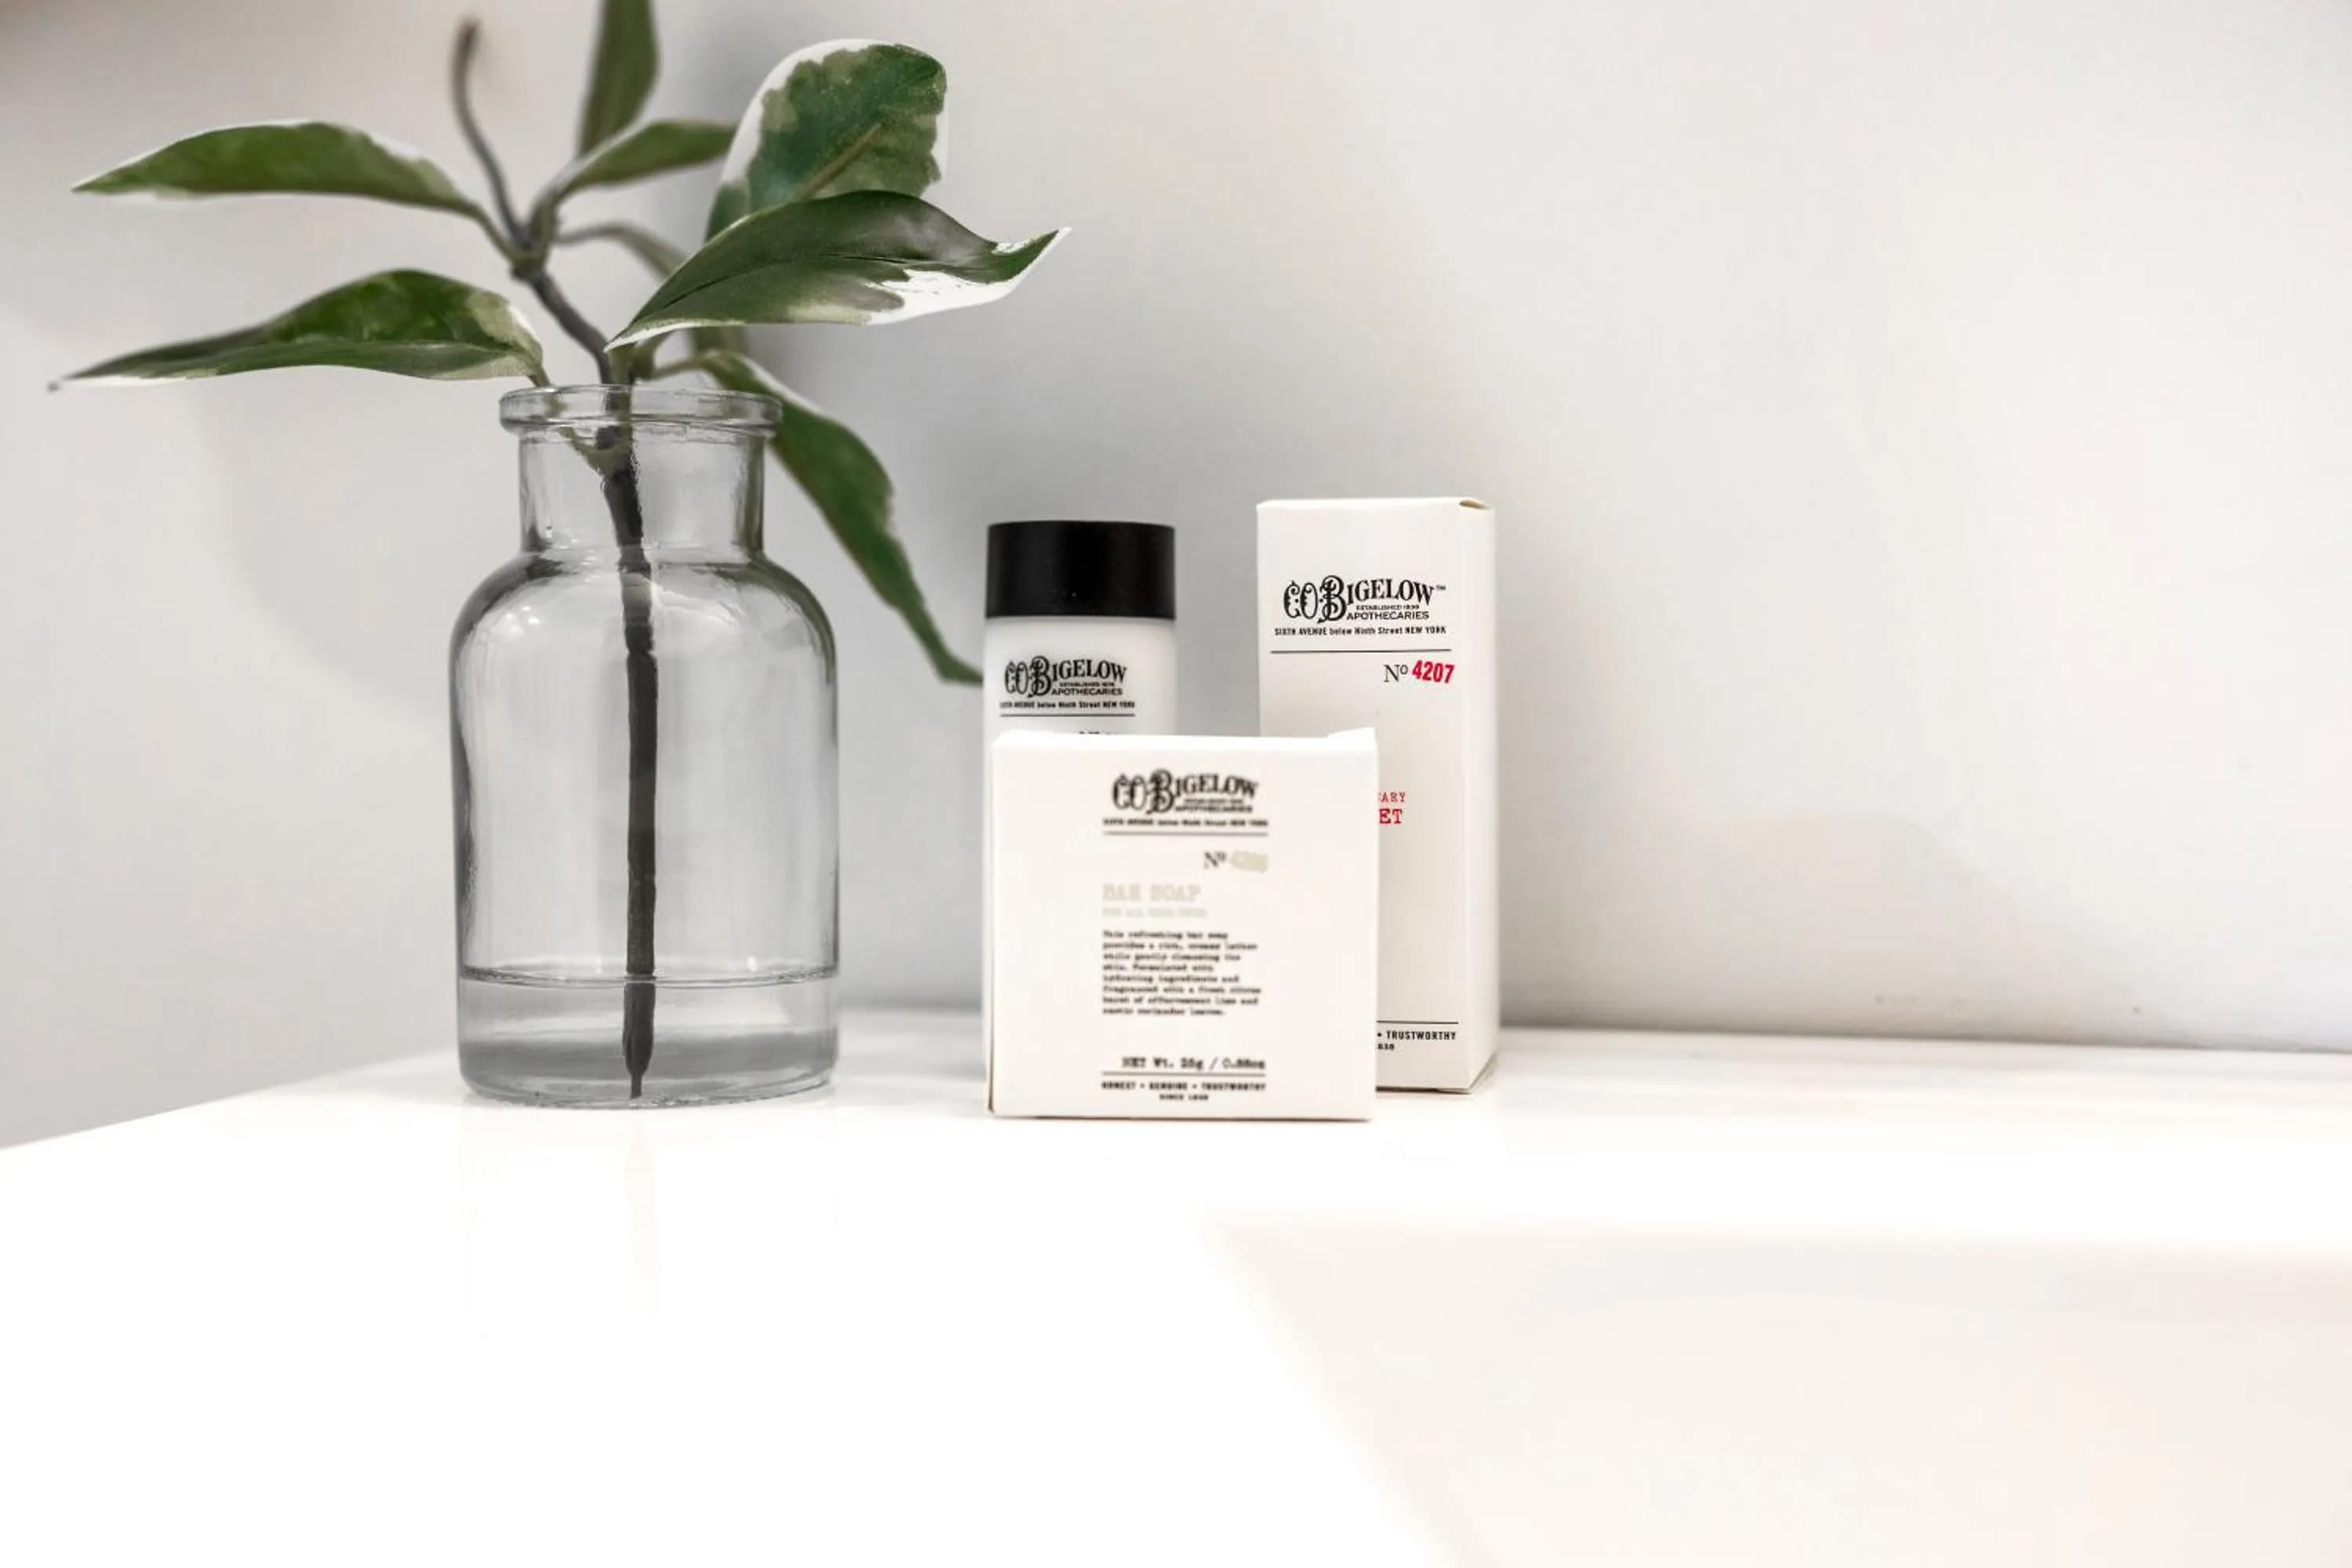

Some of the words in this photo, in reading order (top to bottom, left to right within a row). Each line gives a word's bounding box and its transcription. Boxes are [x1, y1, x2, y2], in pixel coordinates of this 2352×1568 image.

[1346, 611, 1430, 620] APOTHECARIES
[1275, 627, 1296, 636] SIXTH
[1354, 626, 1376, 635] Ninth
[1425, 626, 1446, 634] YORK
[1412, 659, 1455, 684] 4207
[1052, 688, 1123, 696] APOTHECARIES
[1378, 791, 1406, 802] ARY
[1379, 808, 1403, 824] ET
[1102, 883, 1142, 902] BAR
[1149, 884, 1201, 902] SOAP
[1386, 1030, 1456, 1040] TRUSTWORTHY
[1122, 1057, 1146, 1069] NET
[1102, 1081, 1136, 1090] HONEST
[1149, 1081, 1188, 1090] GENUINE
[1201, 1082, 1266, 1091] TRUSTWORTHY
